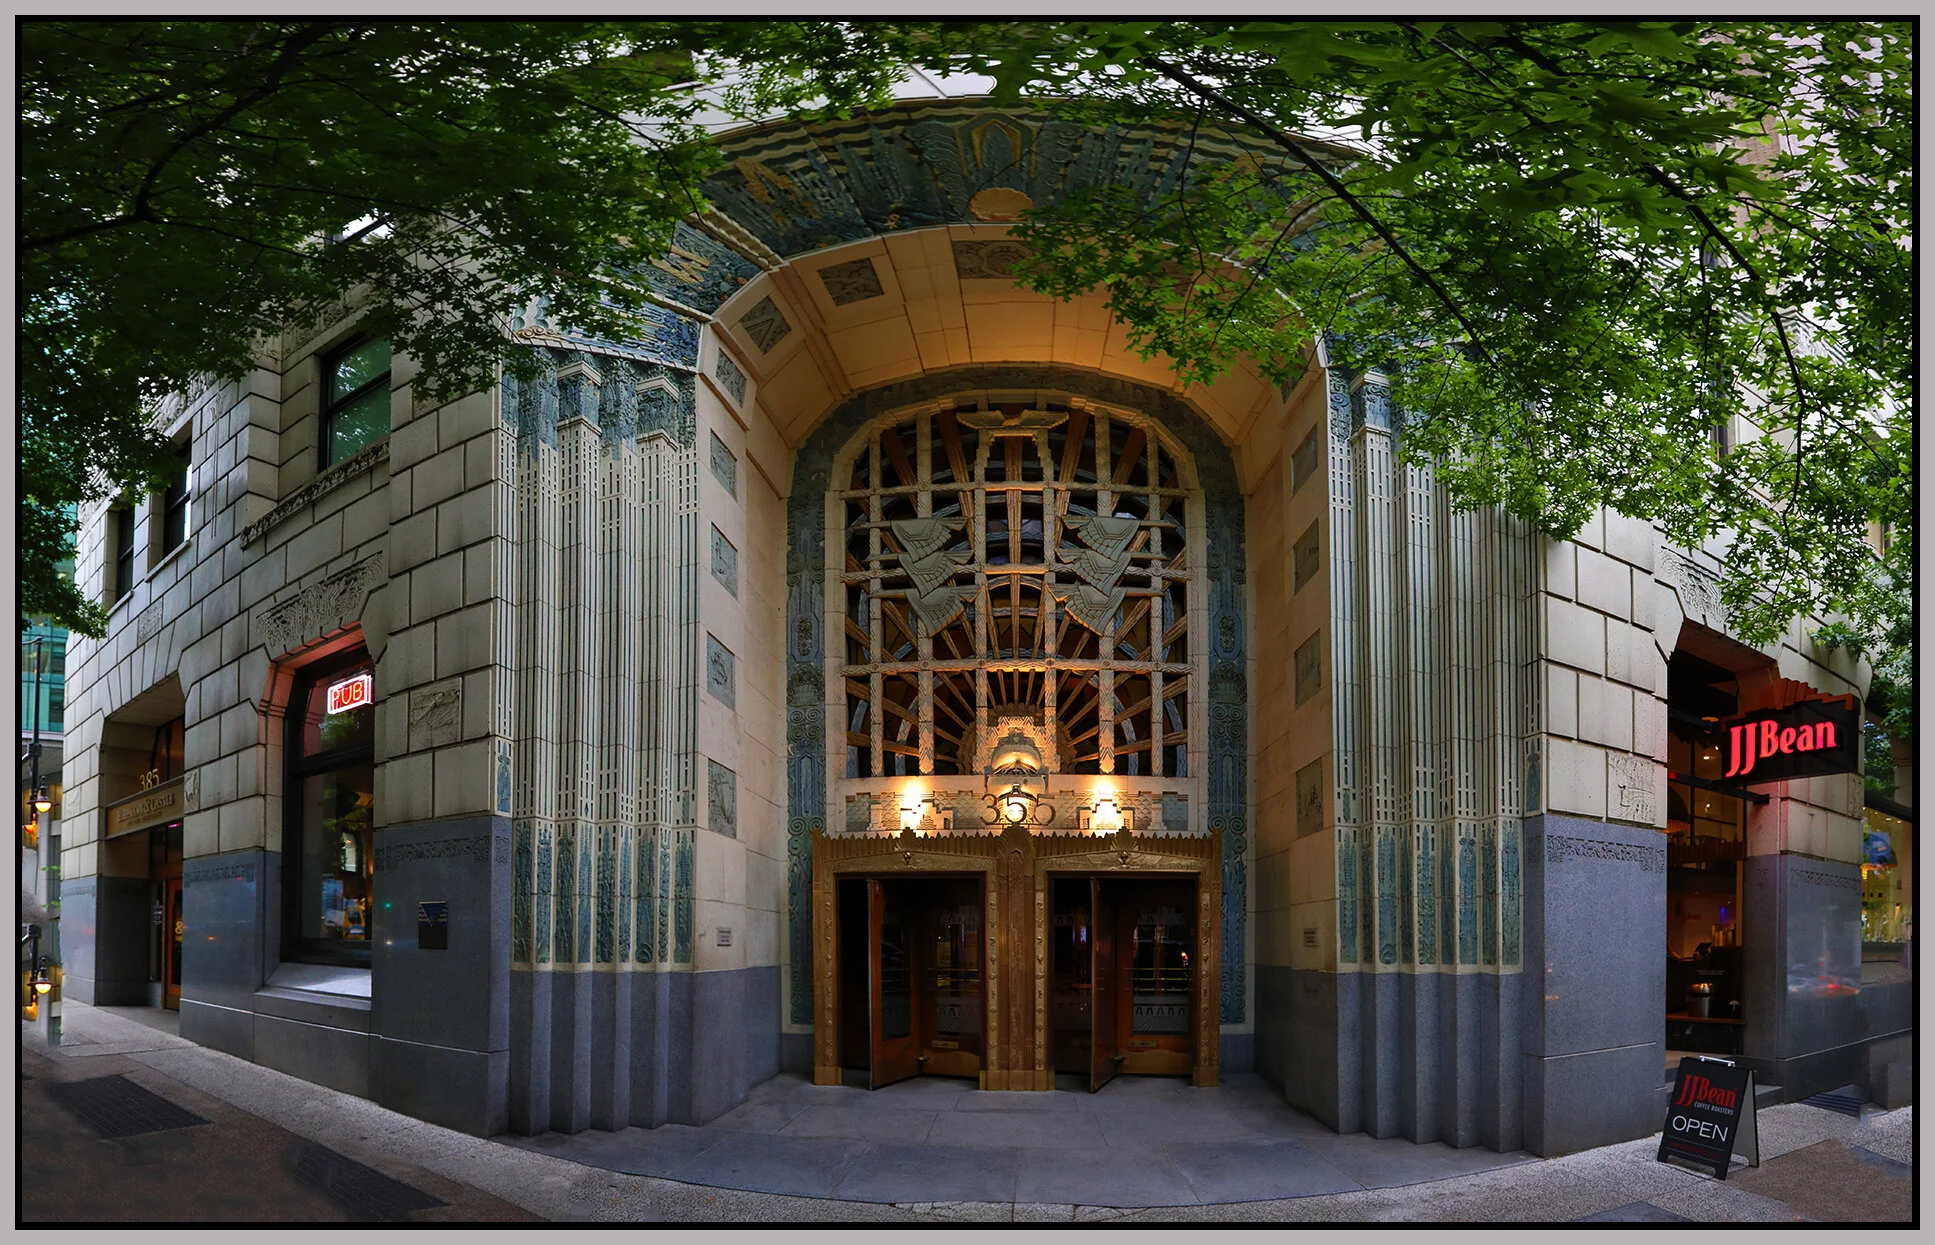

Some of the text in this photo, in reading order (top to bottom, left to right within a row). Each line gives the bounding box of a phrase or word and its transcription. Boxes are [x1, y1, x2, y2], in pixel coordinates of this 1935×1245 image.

[331, 681, 363, 711] PUB
[140, 768, 160, 791] 385
[980, 793, 1056, 826] 355
[1694, 1101, 1734, 1115] COFFEE ROASTERS
[1672, 1115, 1729, 1142] OPEN
